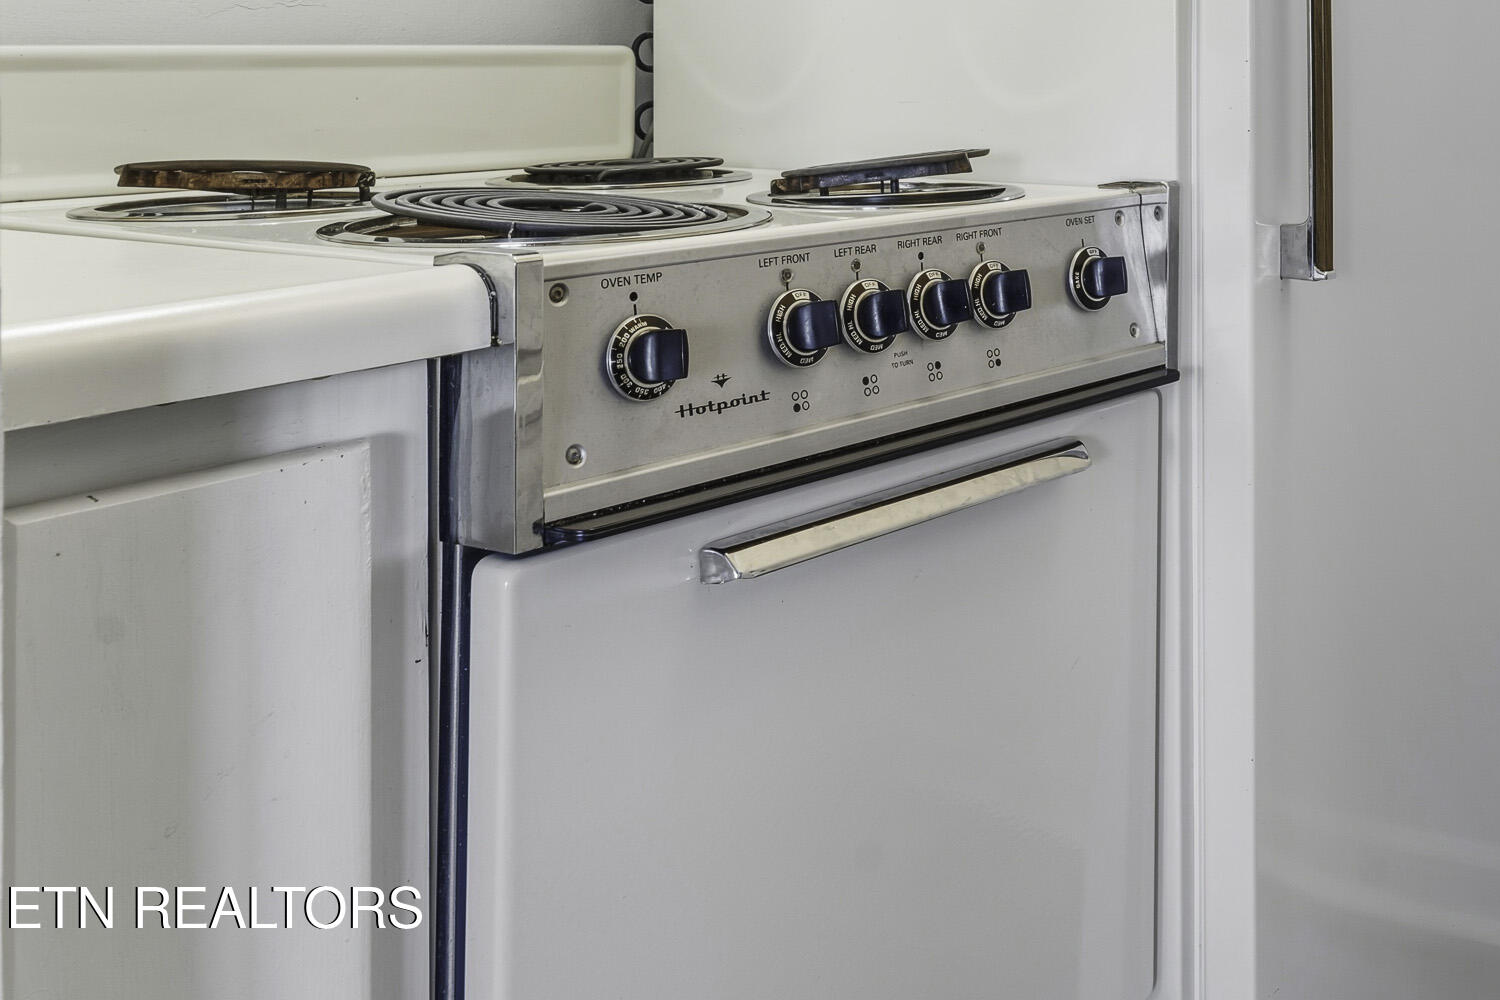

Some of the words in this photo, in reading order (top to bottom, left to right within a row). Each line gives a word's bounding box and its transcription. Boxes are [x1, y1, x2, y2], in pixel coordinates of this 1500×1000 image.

[1066, 216, 1083, 227] OVEN
[1084, 215, 1096, 224] SET
[956, 230, 978, 241] RIGHT
[980, 227, 1002, 238] FRONT
[897, 238, 920, 250] RIGHT
[923, 236, 942, 246] REAR
[834, 247, 853, 258] LEFT
[855, 244, 877, 254] REAR
[759, 256, 779, 268] LEFT
[782, 252, 810, 264] FRONT
[601, 275, 631, 289] OVEN
[634, 272, 663, 285] TEMP
[776, 304, 786, 323] HIGH
[629, 321, 648, 333] WARM
[619, 333, 630, 348] 200
[621, 373, 633, 388] 300
[635, 387, 650, 395] 350
[674, 389, 771, 418] Hotpoint
